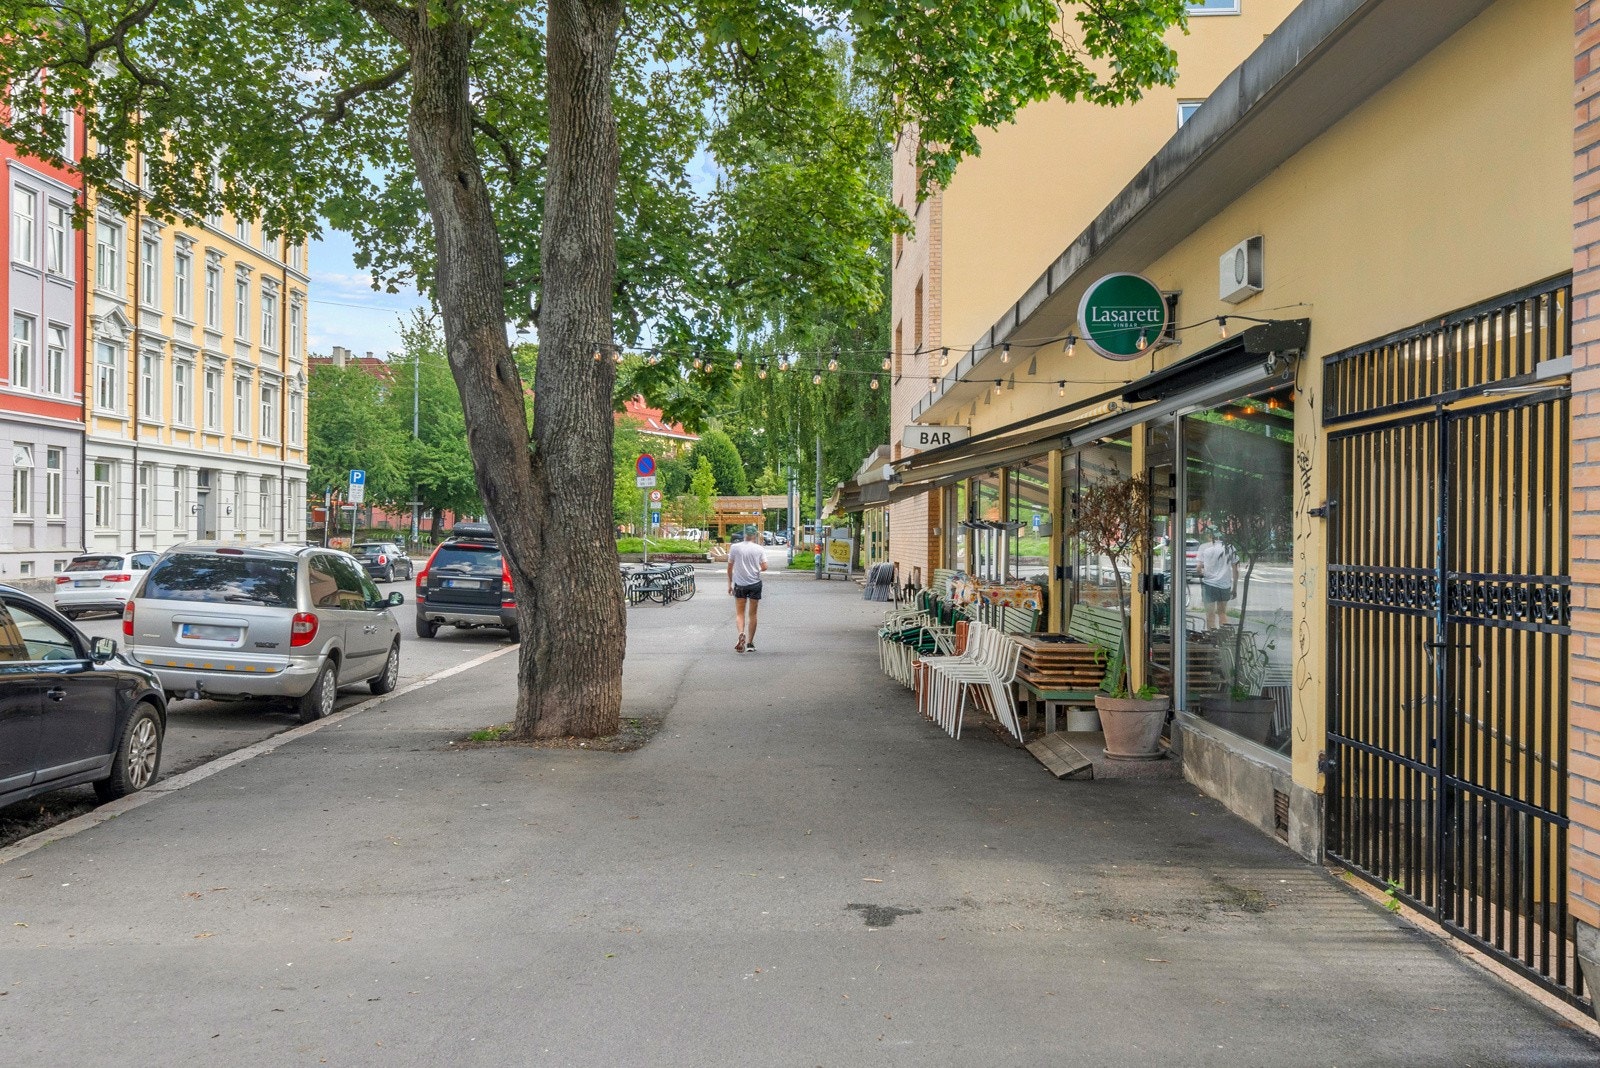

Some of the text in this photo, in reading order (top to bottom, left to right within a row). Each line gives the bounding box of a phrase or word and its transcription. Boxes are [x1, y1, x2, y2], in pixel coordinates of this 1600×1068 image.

[1091, 306, 1161, 322] Lasarett
[919, 432, 951, 445] BAR
[353, 472, 362, 483] P
